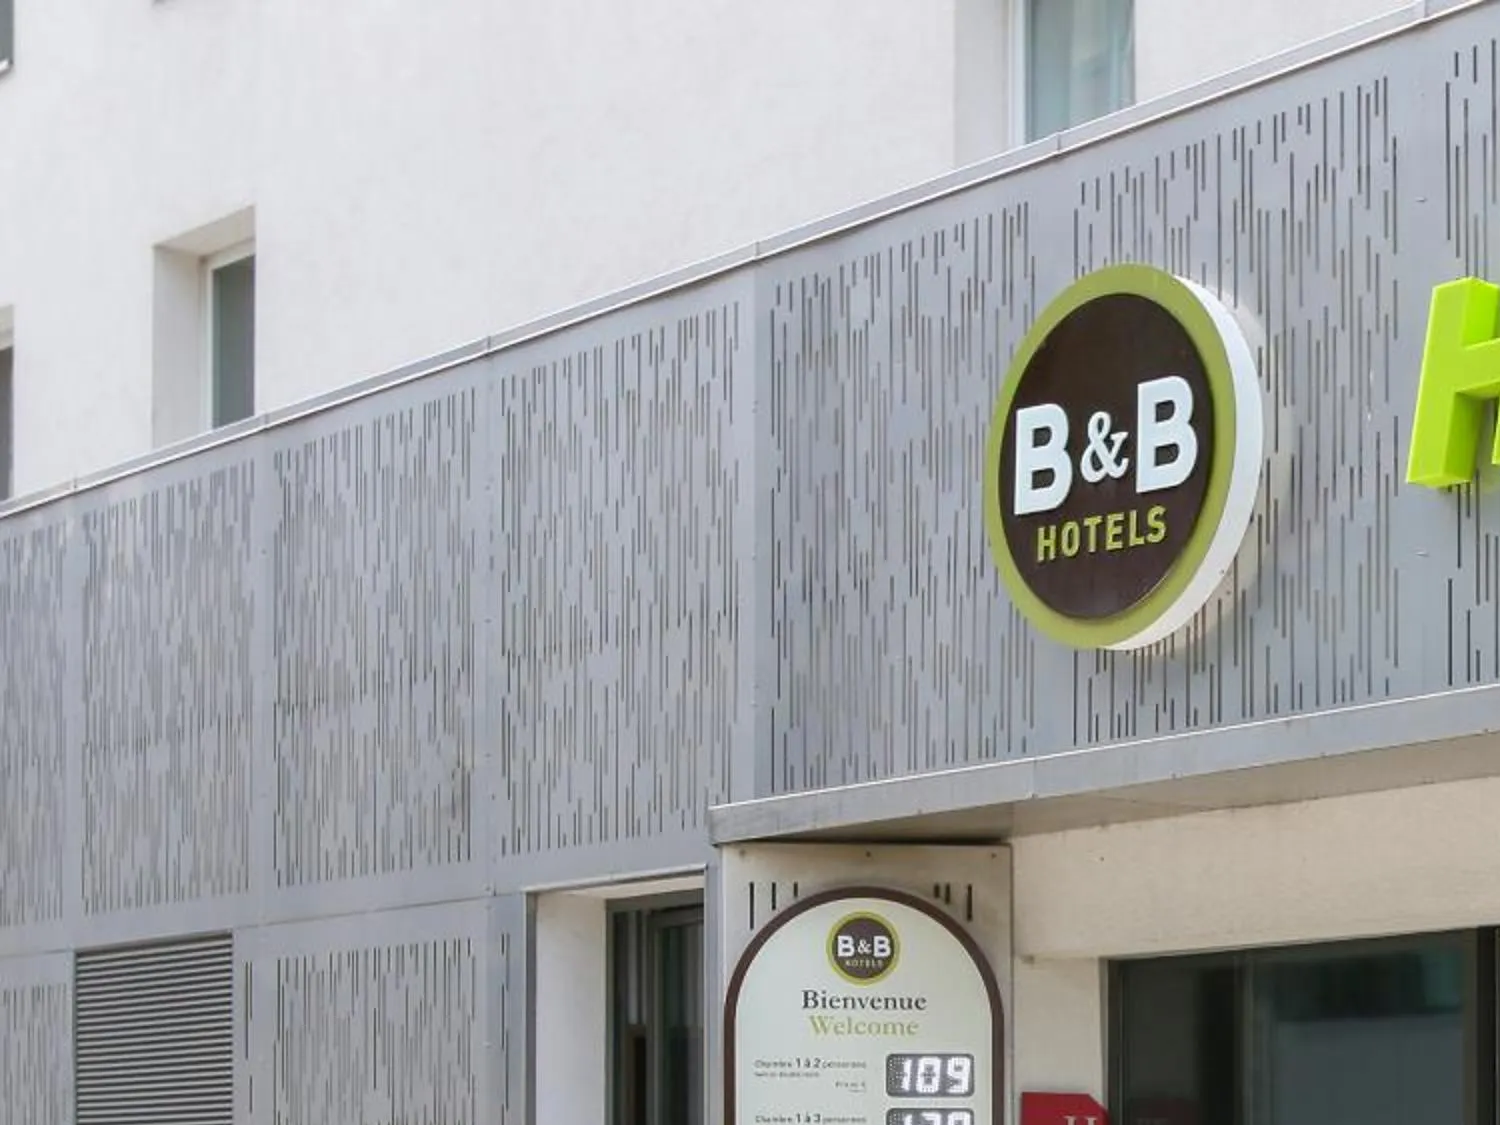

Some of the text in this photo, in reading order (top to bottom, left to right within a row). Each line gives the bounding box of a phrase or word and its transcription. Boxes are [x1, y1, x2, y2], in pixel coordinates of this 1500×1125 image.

[1014, 375, 1198, 516] B&B
[1036, 505, 1169, 563] HOTELS
[837, 934, 892, 958] B&B
[801, 989, 928, 1011] Bienvenue
[808, 1014, 920, 1036] Welcome
[901, 1056, 971, 1093] 109
